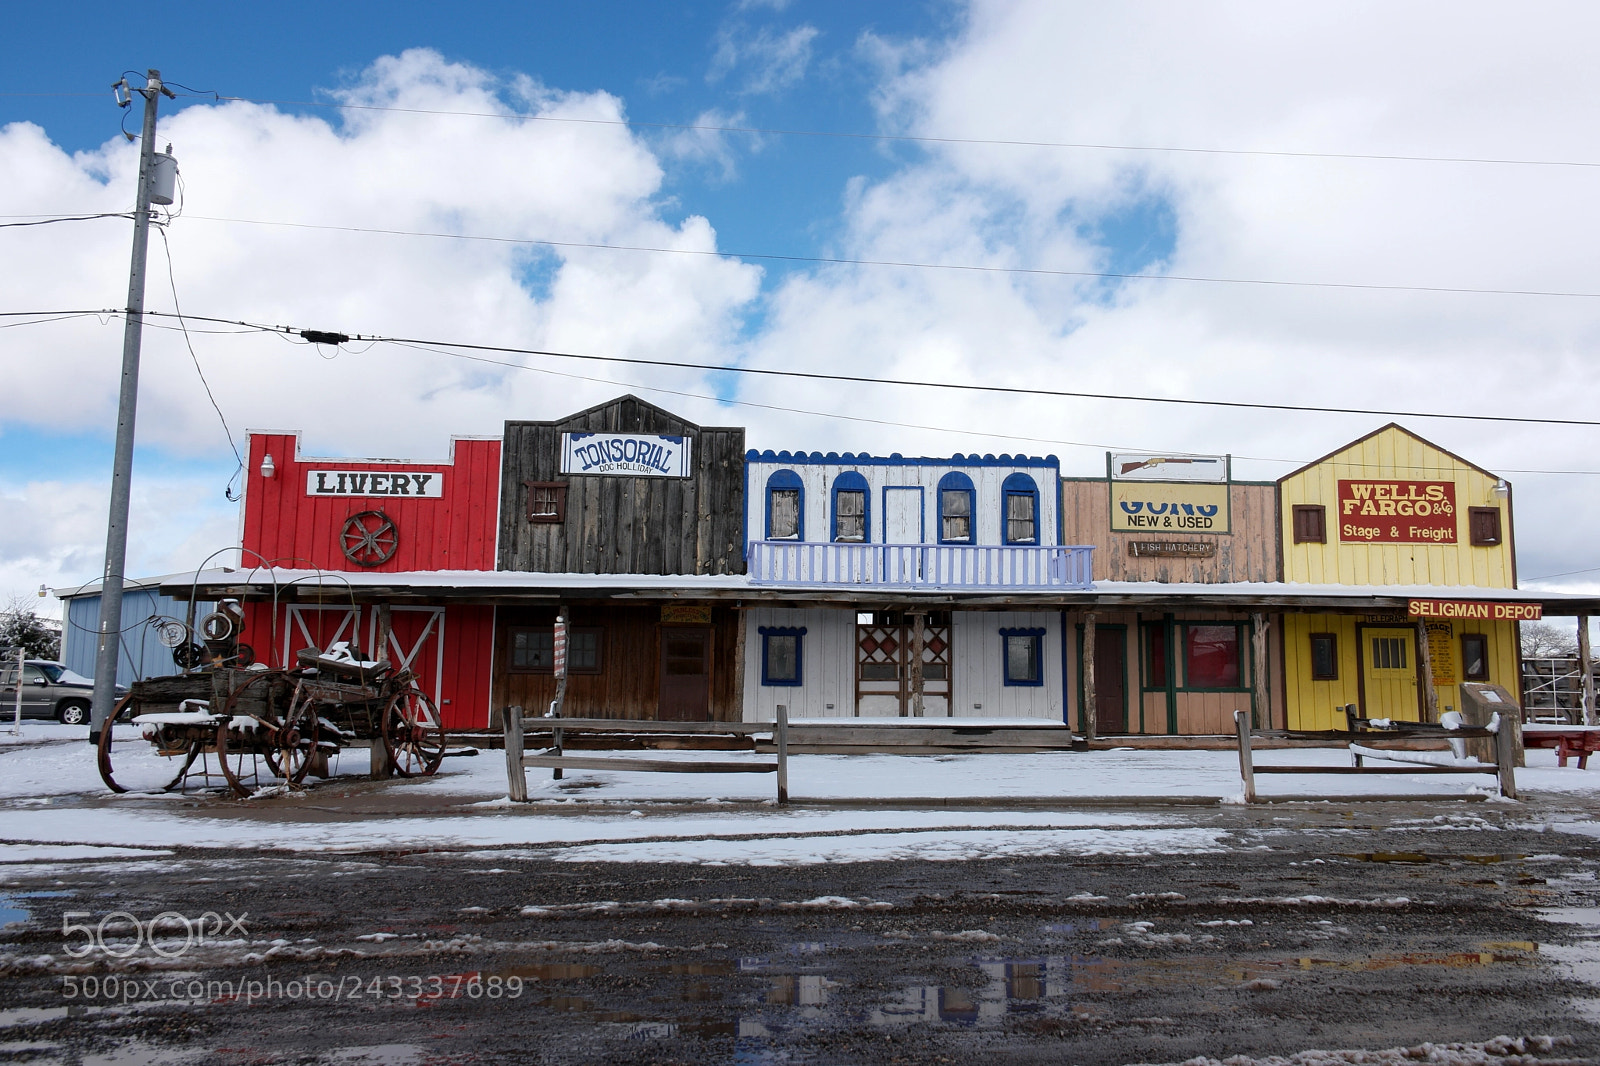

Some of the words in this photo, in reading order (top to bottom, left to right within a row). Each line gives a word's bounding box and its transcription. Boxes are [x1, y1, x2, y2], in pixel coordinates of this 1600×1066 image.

[574, 439, 672, 474] TONSORIAL
[599, 463, 614, 472] DOC
[616, 462, 653, 474] HOLLIDAY
[316, 473, 432, 495] LIVERY
[1127, 515, 1159, 527] NEW
[1163, 516, 1172, 528] &
[1177, 516, 1213, 528] USED
[1343, 524, 1381, 539] Stage
[1390, 526, 1399, 537] &
[1409, 526, 1453, 541] Freight
[1140, 543, 1160, 551] FISH
[1165, 543, 1210, 552] HATCHERY
[1409, 601, 1488, 618] SELIGMAN
[1494, 605, 1541, 619] DEPOT
[1367, 614, 1408, 623] TELEGRAPH
